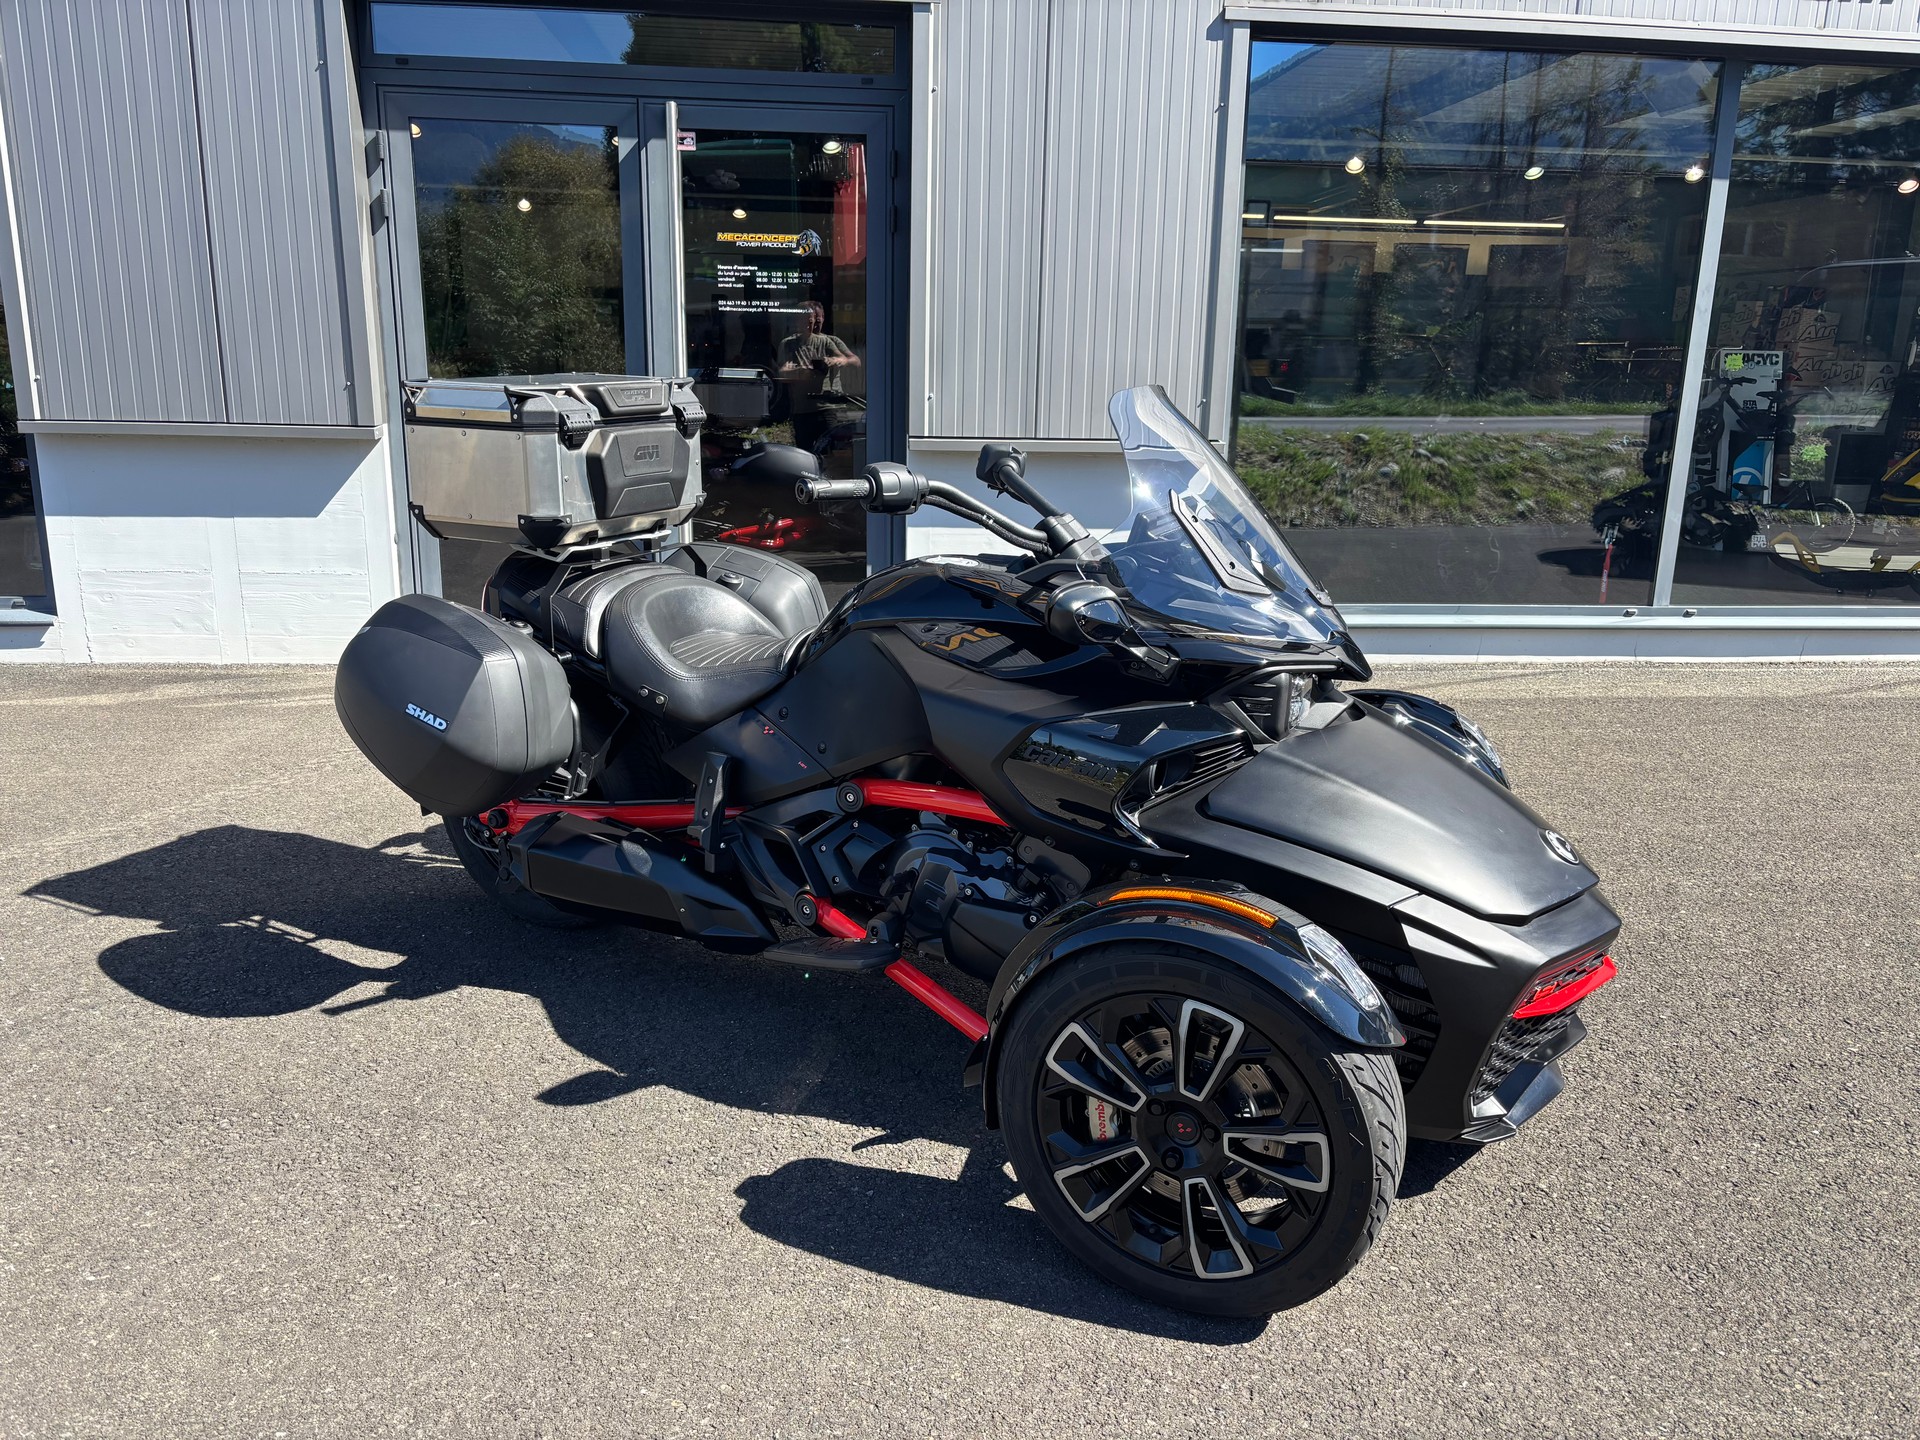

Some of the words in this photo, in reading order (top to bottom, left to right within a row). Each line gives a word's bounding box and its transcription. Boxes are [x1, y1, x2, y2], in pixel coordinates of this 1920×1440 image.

[717, 232, 799, 242] MECACONCEPT
[1724, 352, 1780, 367] ACYC
[405, 702, 448, 731] SHAD
